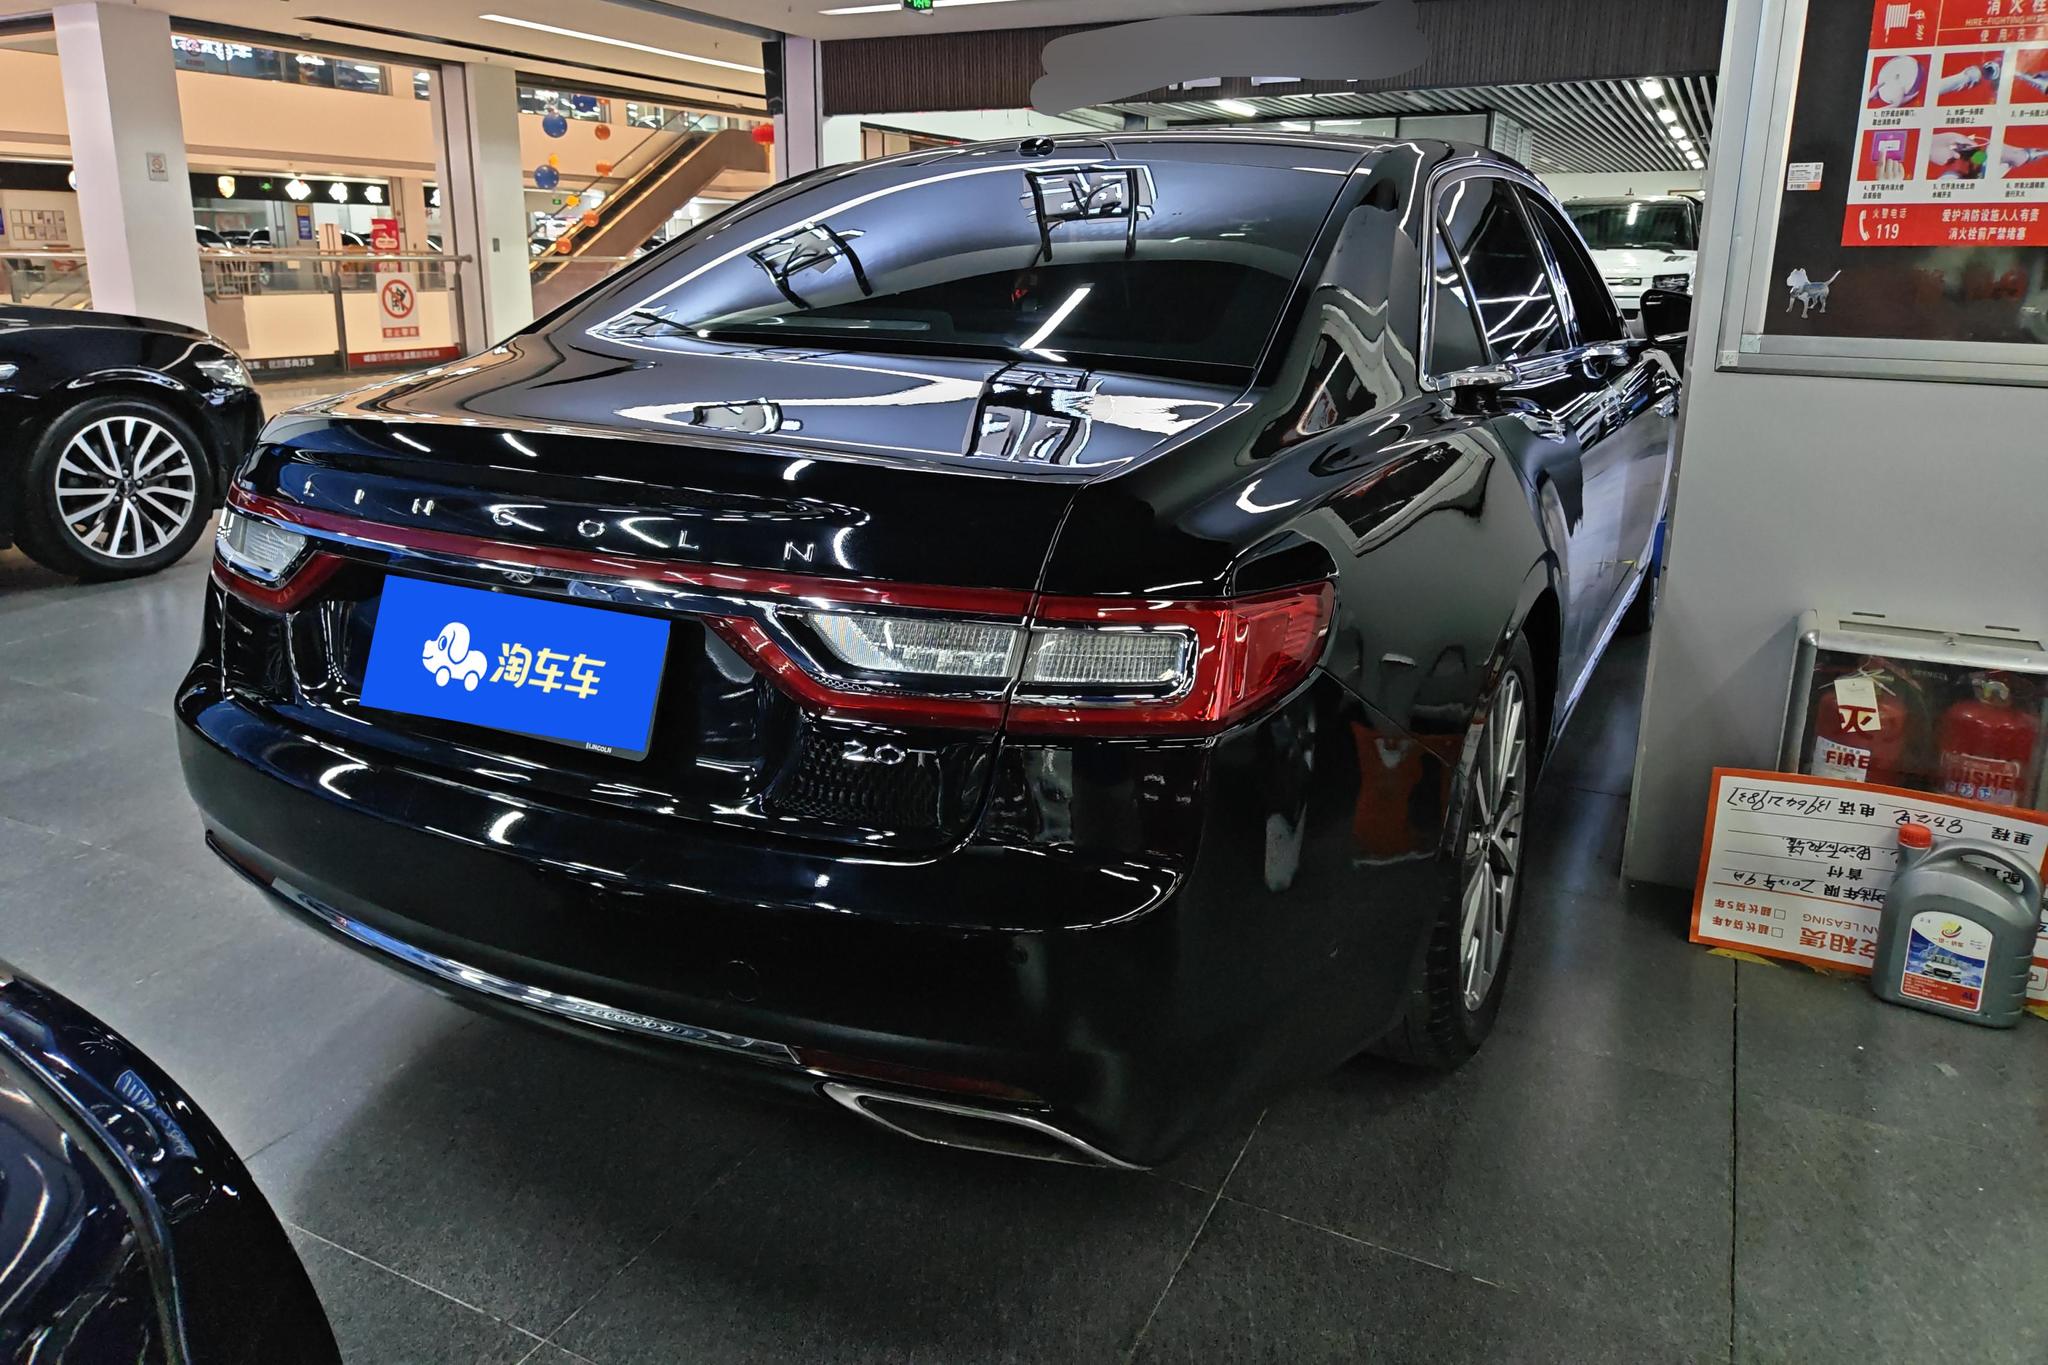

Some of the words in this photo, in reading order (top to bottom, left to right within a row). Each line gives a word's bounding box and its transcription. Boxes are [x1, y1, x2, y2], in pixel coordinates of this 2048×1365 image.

[1872, 208, 1908, 219] 火警电话
[1941, 208, 2040, 222] 爱护消防设施人人有责
[1876, 223, 1900, 240] 119
[1948, 227, 2027, 241] 消火栓前严禁堵塞
[304, 480, 814, 562] LINCOLN
[587, 742, 612, 753] LINCOLN
[1825, 750, 1872, 770] FIRE
[1838, 800, 1875, 817] 电话
[1991, 827, 2034, 845] 里程
[1827, 866, 1863, 880] 首付
[1802, 913, 1860, 932] LEASING
